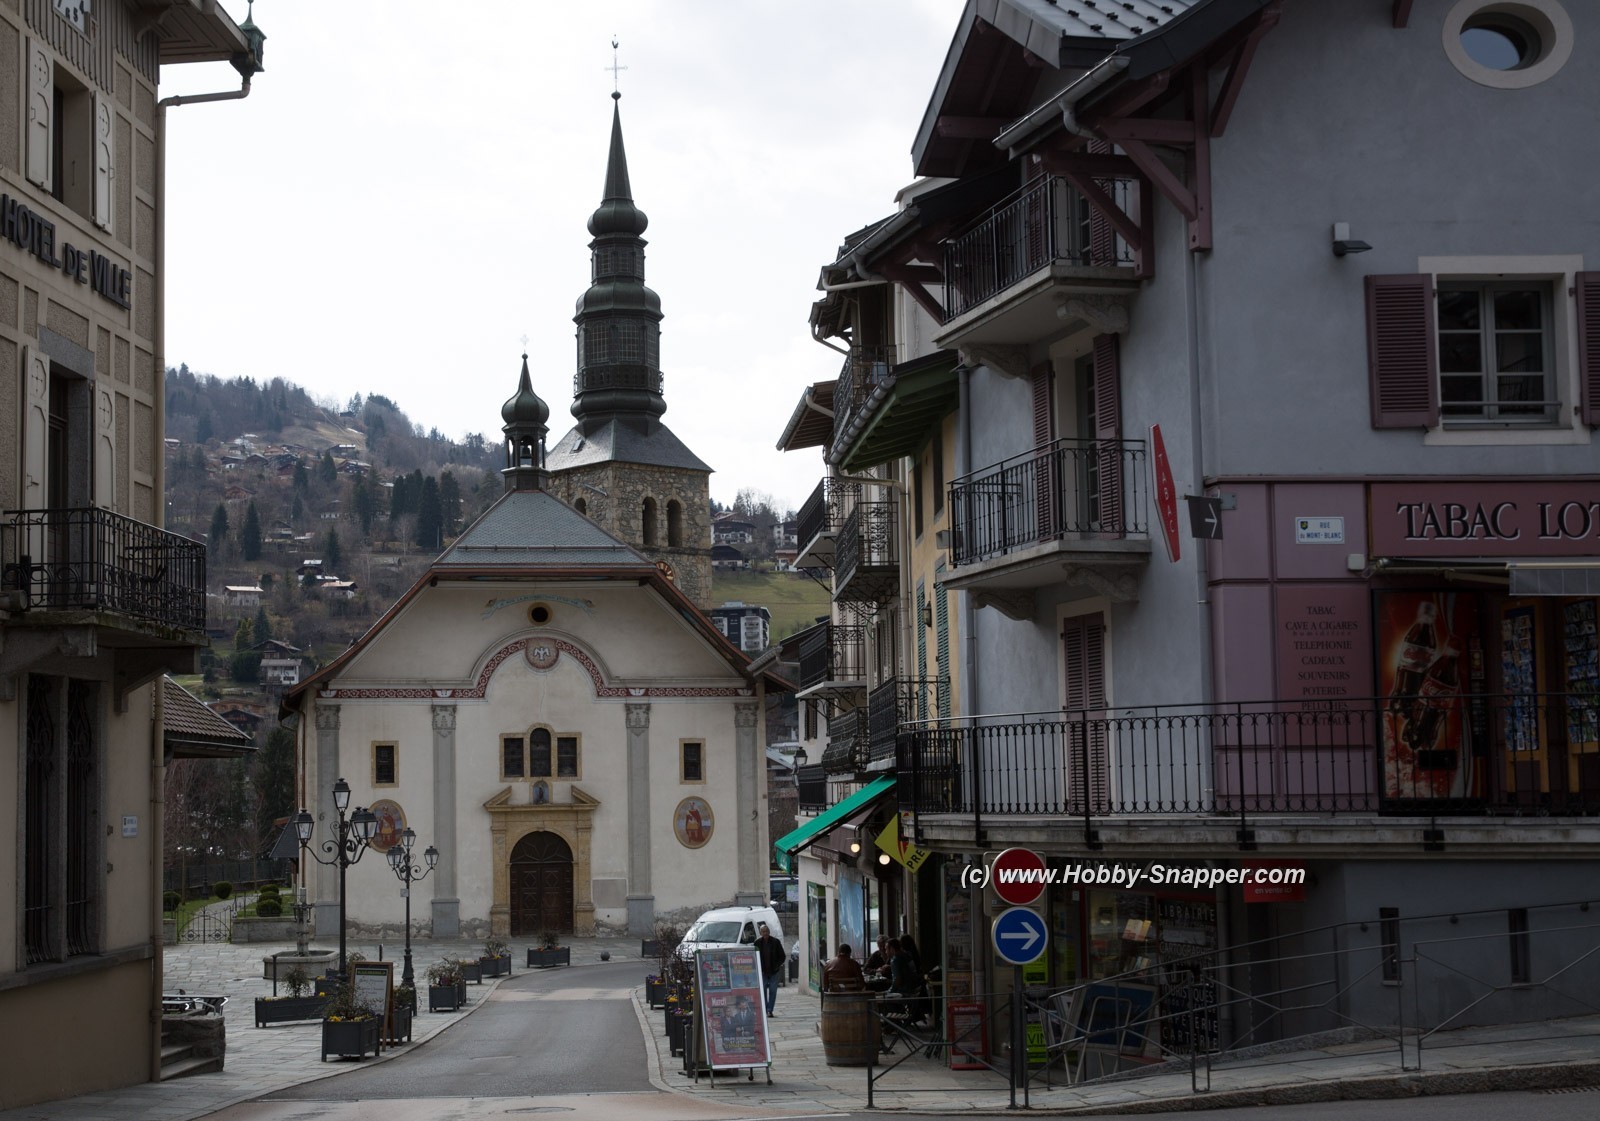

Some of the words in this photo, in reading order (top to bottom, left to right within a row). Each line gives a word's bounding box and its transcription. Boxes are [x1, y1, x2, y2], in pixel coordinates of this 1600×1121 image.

[64, 243, 88, 284] DE
[90, 250, 132, 310] VILLE
[1397, 502, 1520, 540] TABAC
[1307, 606, 1336, 615] TABAC
[1285, 622, 1308, 631] CAVE
[1319, 621, 1358, 630] CIGARES
[1294, 641, 1353, 650] TELEPHONIE
[1301, 656, 1346, 665] CADEAUX
[1298, 671, 1350, 680] SOUVENIRS
[1303, 687, 1347, 696] POTERIES
